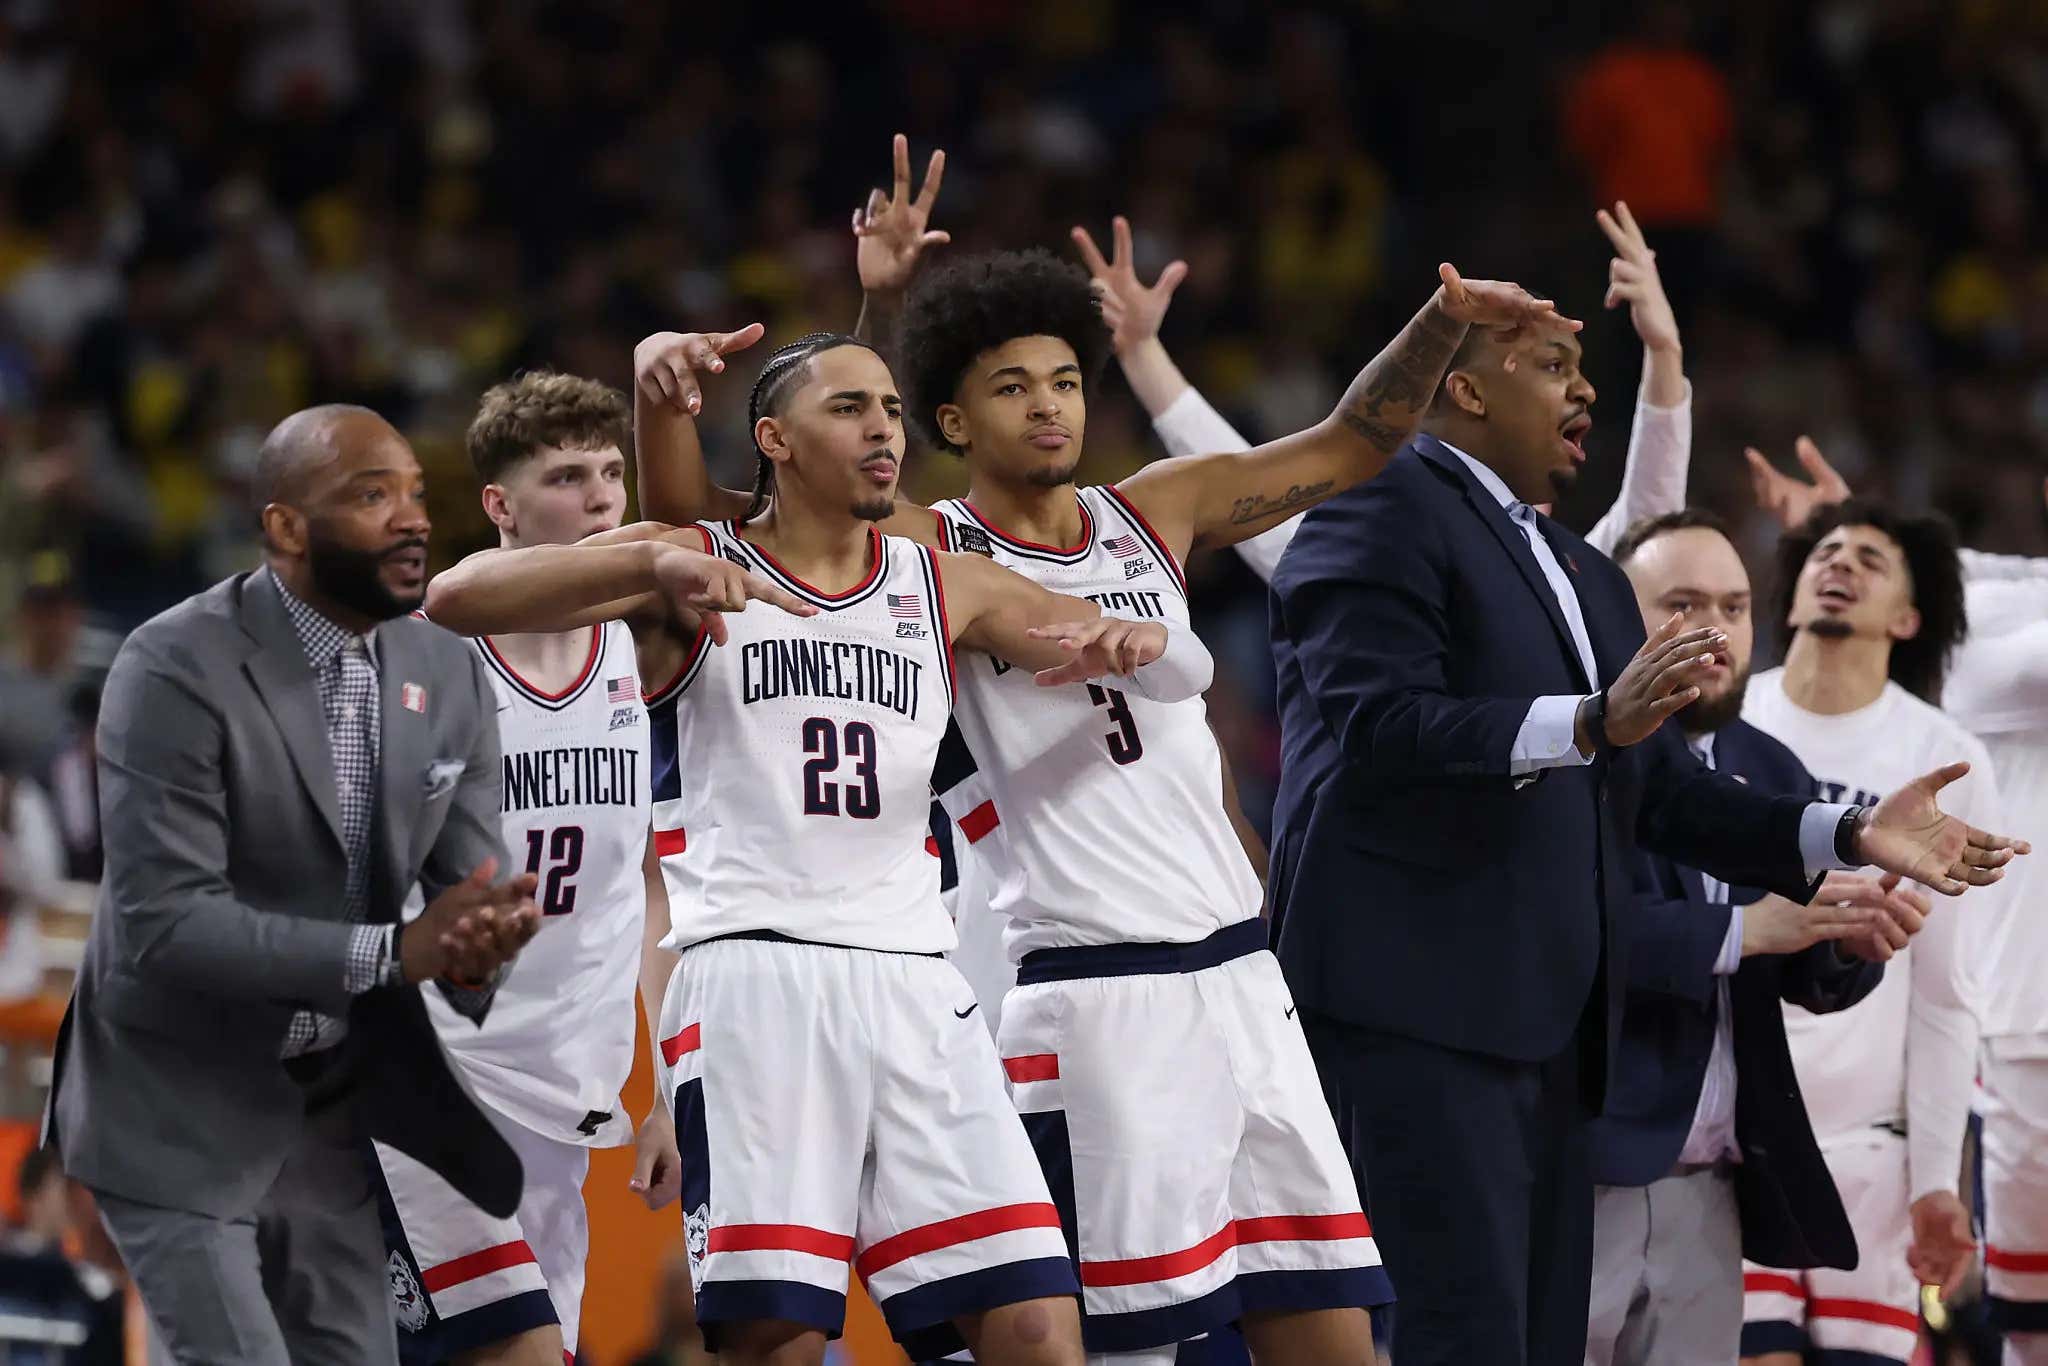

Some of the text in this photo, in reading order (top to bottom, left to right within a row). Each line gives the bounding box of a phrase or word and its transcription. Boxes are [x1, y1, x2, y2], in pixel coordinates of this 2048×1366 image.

[965, 541, 989, 552] FOUR
[1124, 557, 1143, 569] BIG
[1125, 562, 1154, 577] EAST
[897, 621, 920, 631] BIG
[896, 629, 928, 637] EAST
[742, 638, 922, 721] CONNECTICUT
[613, 707, 633, 717] BIG
[610, 714, 639, 726] EAST
[1086, 683, 1143, 766] 3
[802, 717, 881, 820] 23
[500, 747, 638, 812] NNECTICUT
[525, 826, 584, 916] 12
